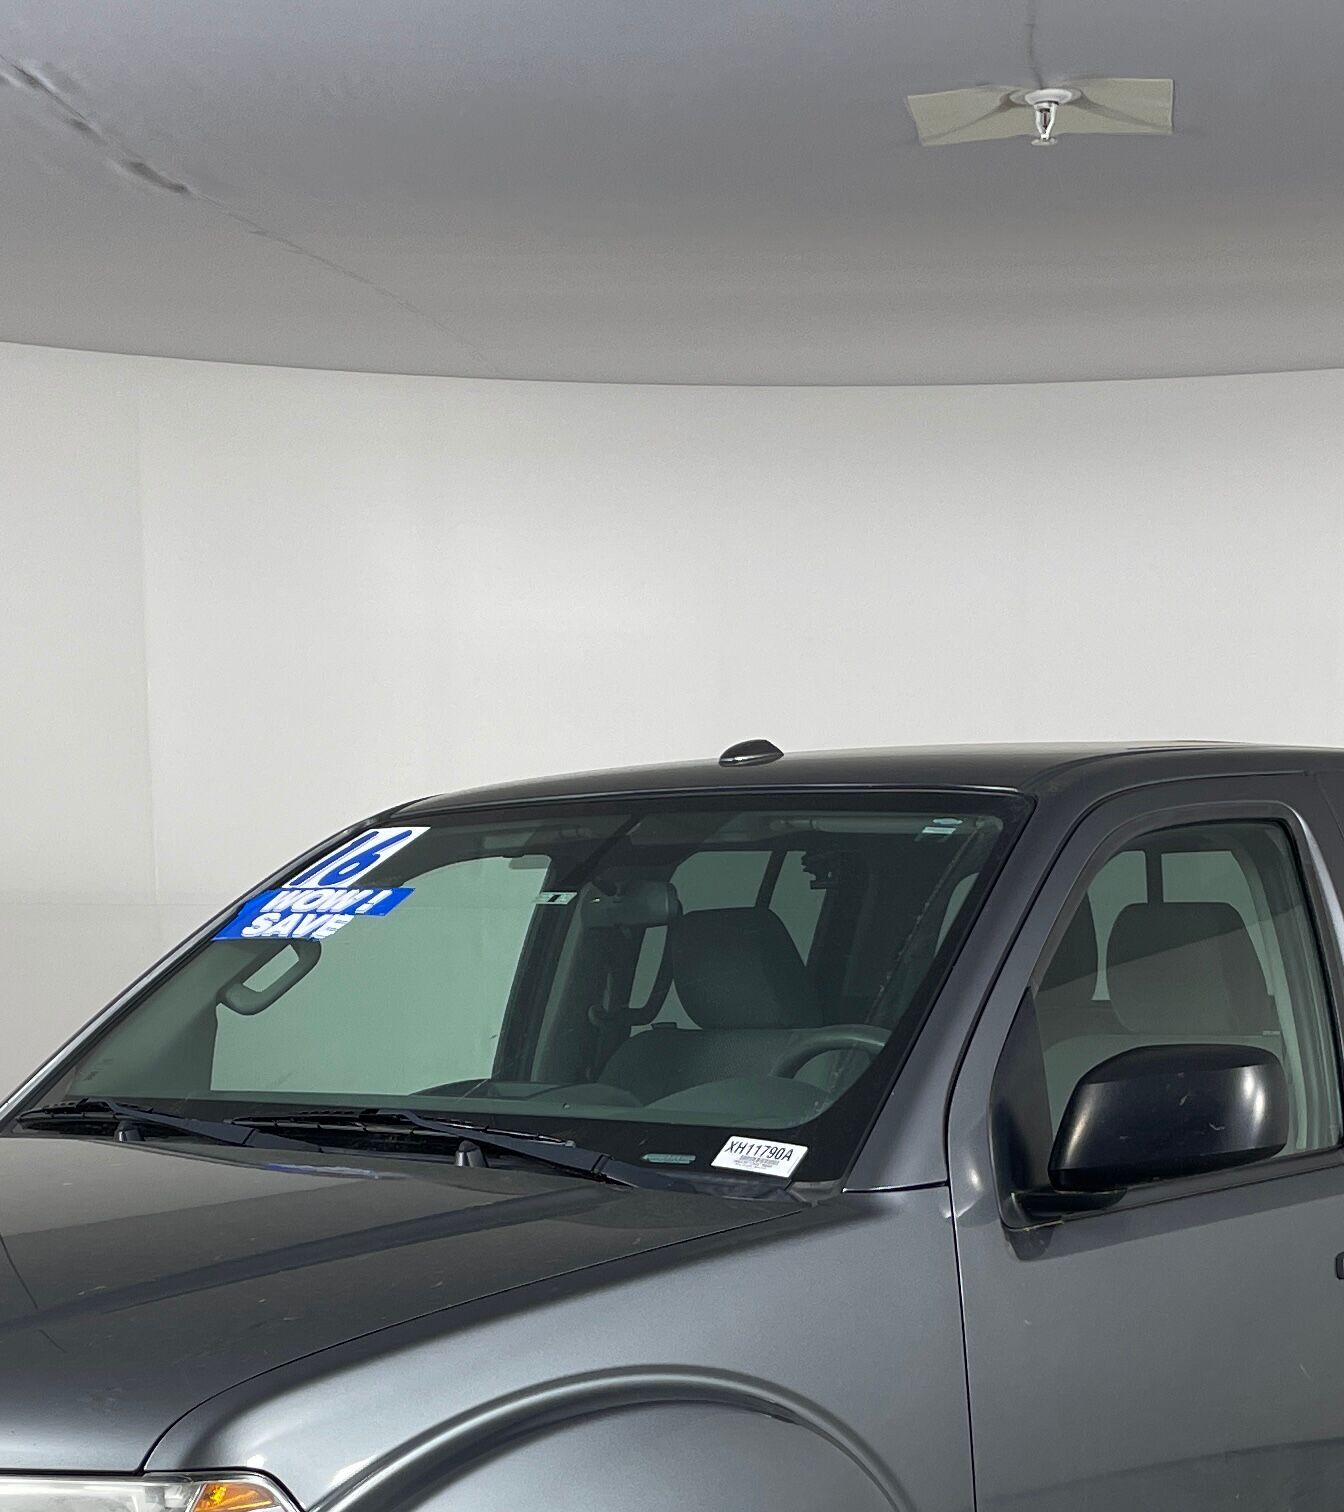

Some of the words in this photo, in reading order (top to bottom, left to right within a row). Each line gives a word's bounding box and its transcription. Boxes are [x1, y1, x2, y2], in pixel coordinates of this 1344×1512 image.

[288, 829, 413, 887] 16
[240, 912, 355, 940] SAVE
[724, 1140, 794, 1162] XH11790A
